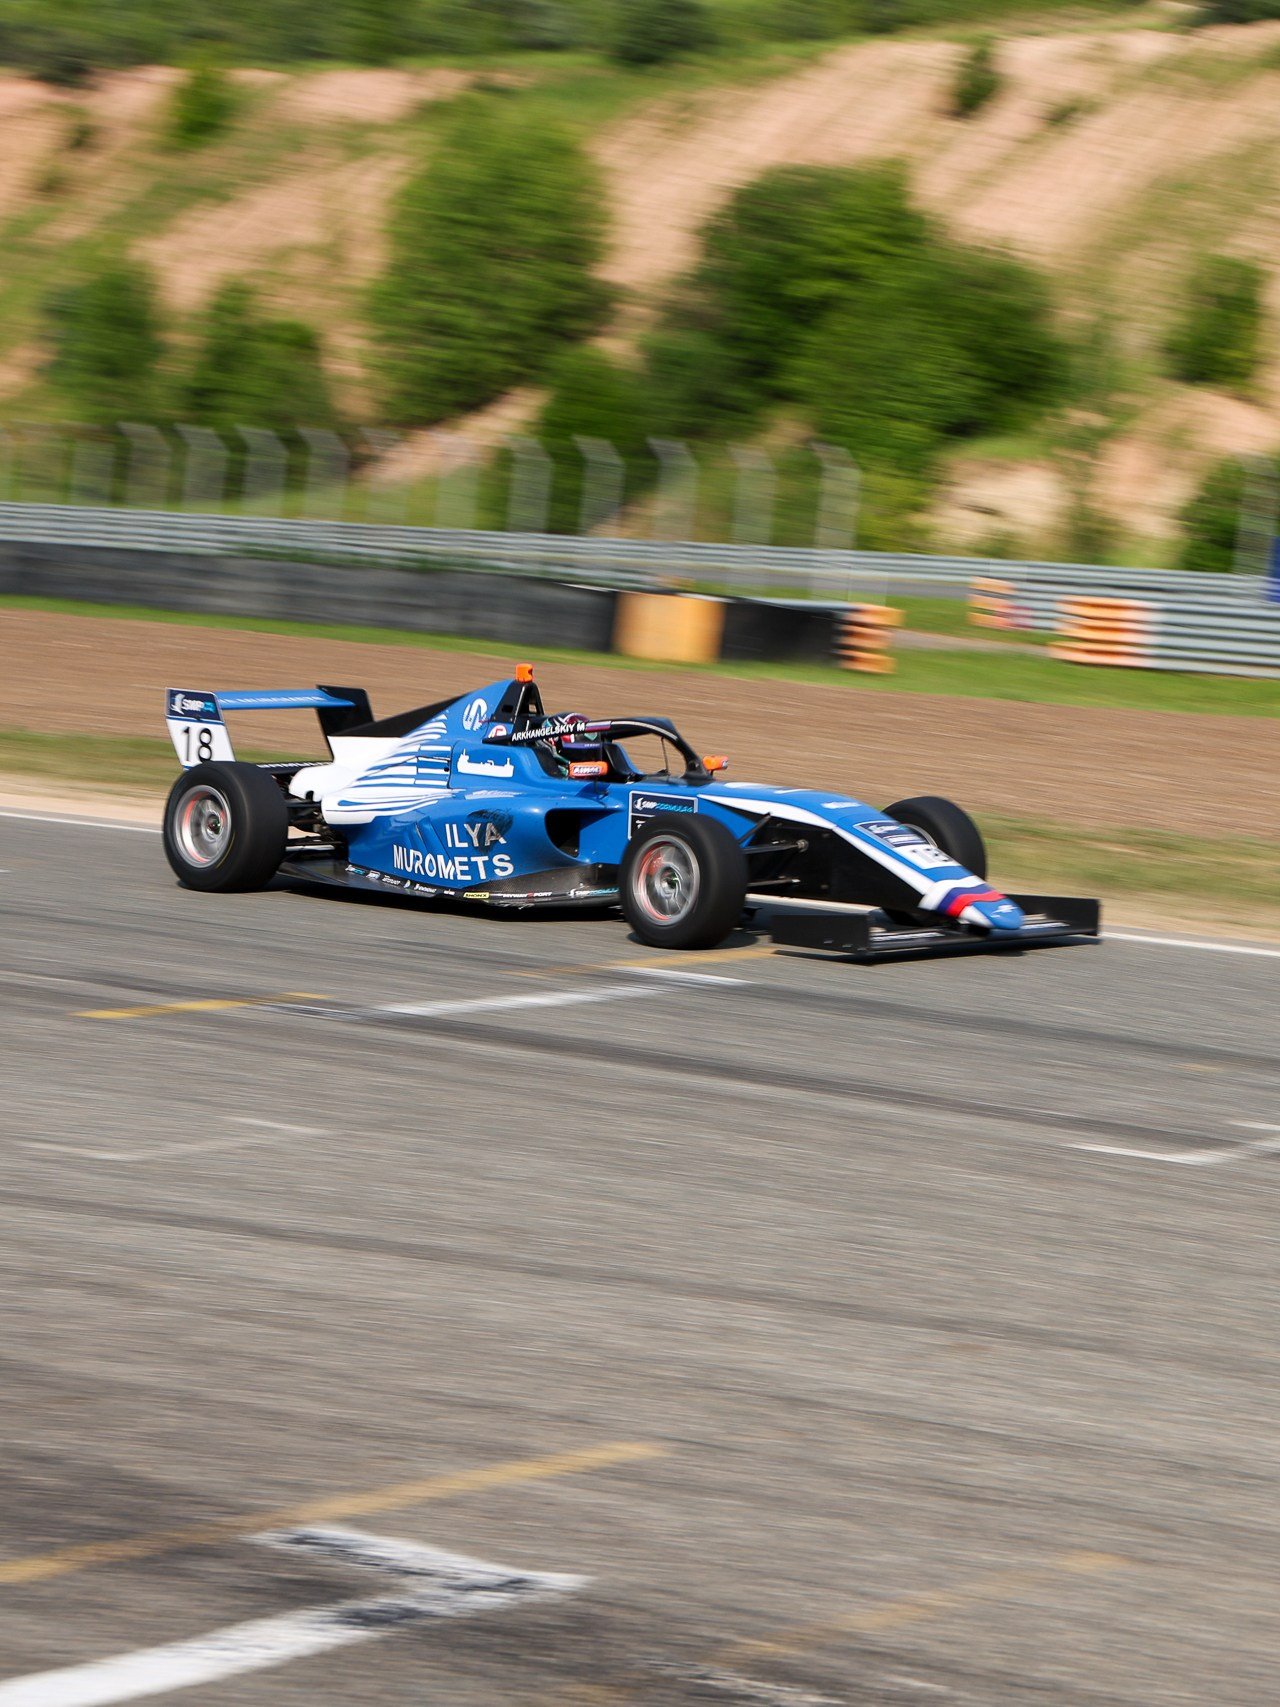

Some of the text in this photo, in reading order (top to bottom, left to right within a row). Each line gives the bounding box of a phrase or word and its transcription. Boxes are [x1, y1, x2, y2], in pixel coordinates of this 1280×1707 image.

[182, 727, 212, 762] 18
[511, 723, 575, 742] ARKHANGELSKIY
[576, 722, 586, 732] M
[445, 822, 507, 848] ILYA
[393, 844, 515, 881] MUROMETS
